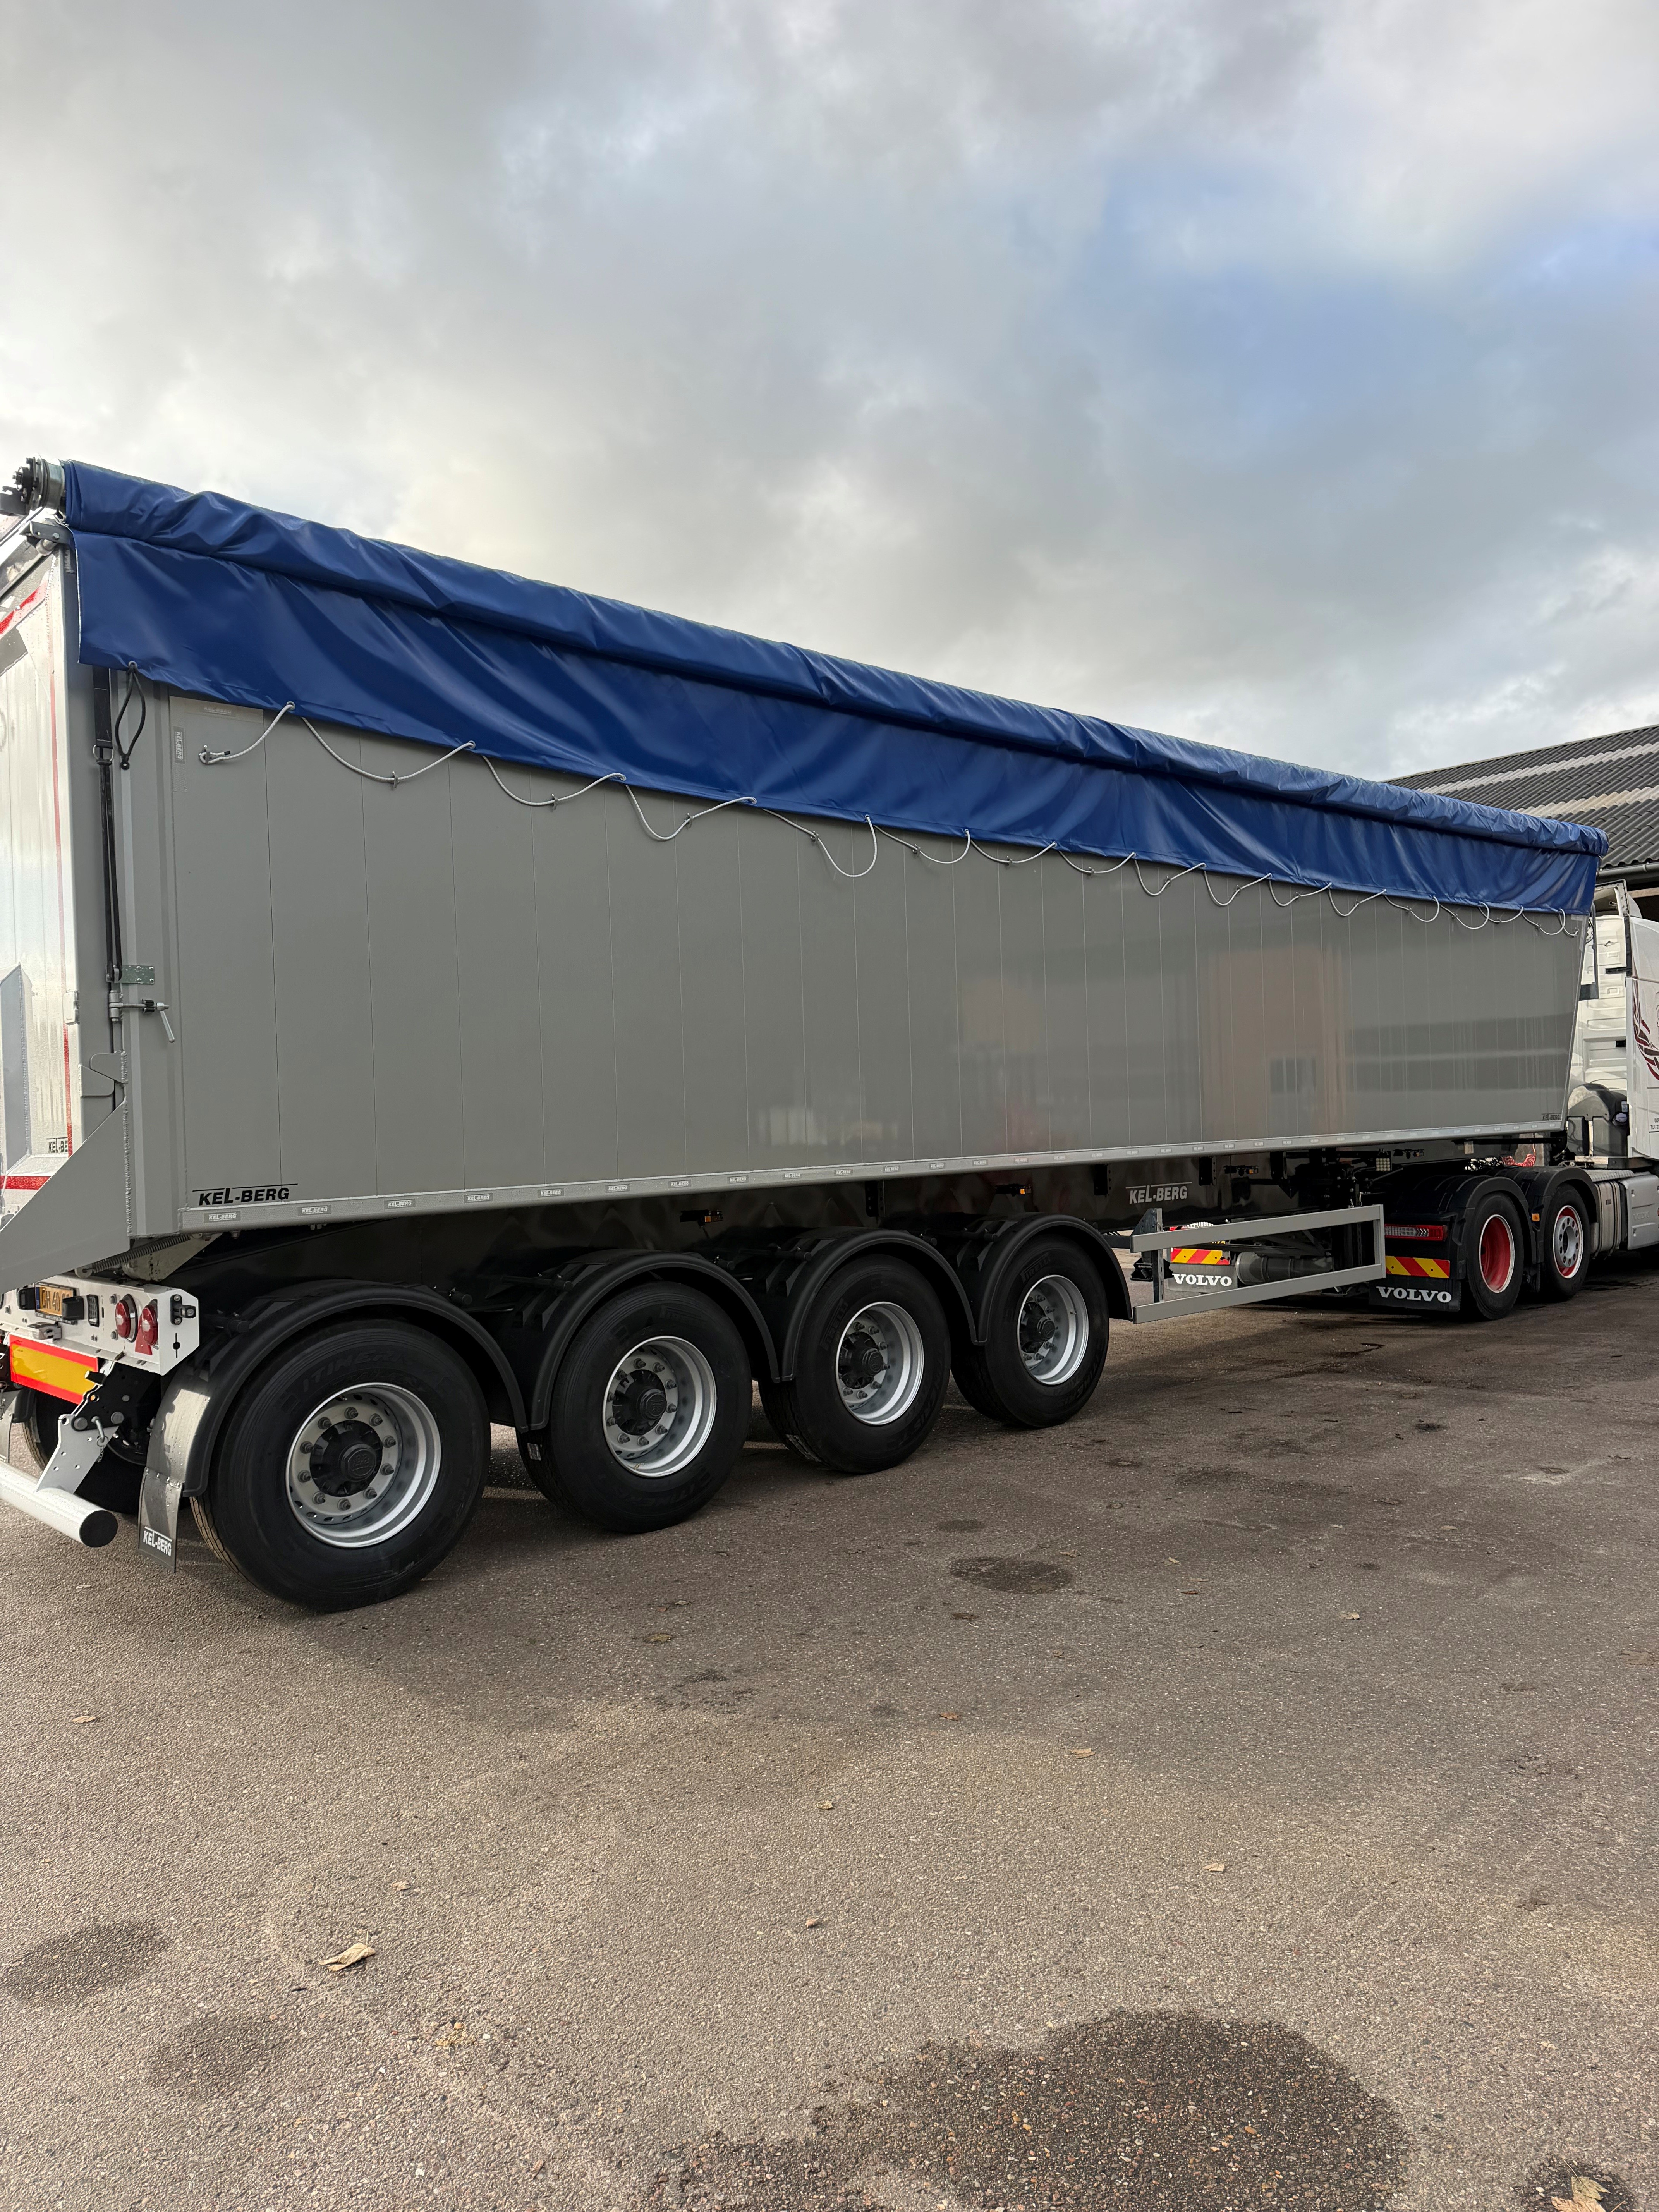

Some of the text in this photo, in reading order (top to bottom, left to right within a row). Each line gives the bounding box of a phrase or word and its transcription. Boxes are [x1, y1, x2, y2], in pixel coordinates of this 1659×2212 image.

[48, 1138, 68, 1153] KEL-BE
[199, 1187, 289, 1206] KEL-BERG
[1130, 1185, 1187, 1204] KEL-BERG
[1172, 1273, 1232, 1286] VOLVO
[1376, 1286, 1452, 1303] VOLVO
[143, 1530, 172, 1556] KEL-BERG
